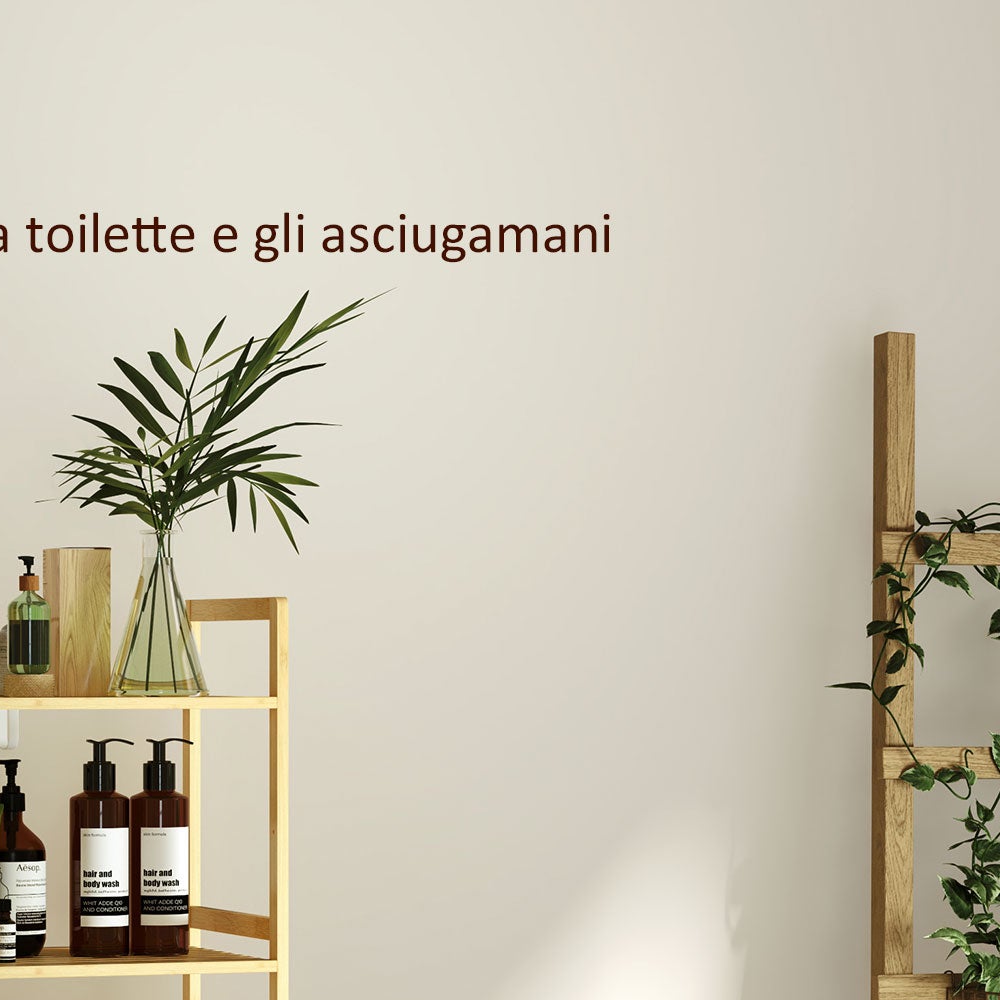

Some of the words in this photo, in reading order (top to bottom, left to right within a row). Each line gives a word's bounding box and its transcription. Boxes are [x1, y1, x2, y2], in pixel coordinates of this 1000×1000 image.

[83, 870, 97, 878] hair
[98, 870, 113, 878] and
[143, 869, 158, 877] hair
[159, 869, 173, 877] and
[83, 880, 101, 889] body
[101, 880, 120, 888] wash
[143, 879, 161, 888] body
[161, 879, 180, 887] wash
